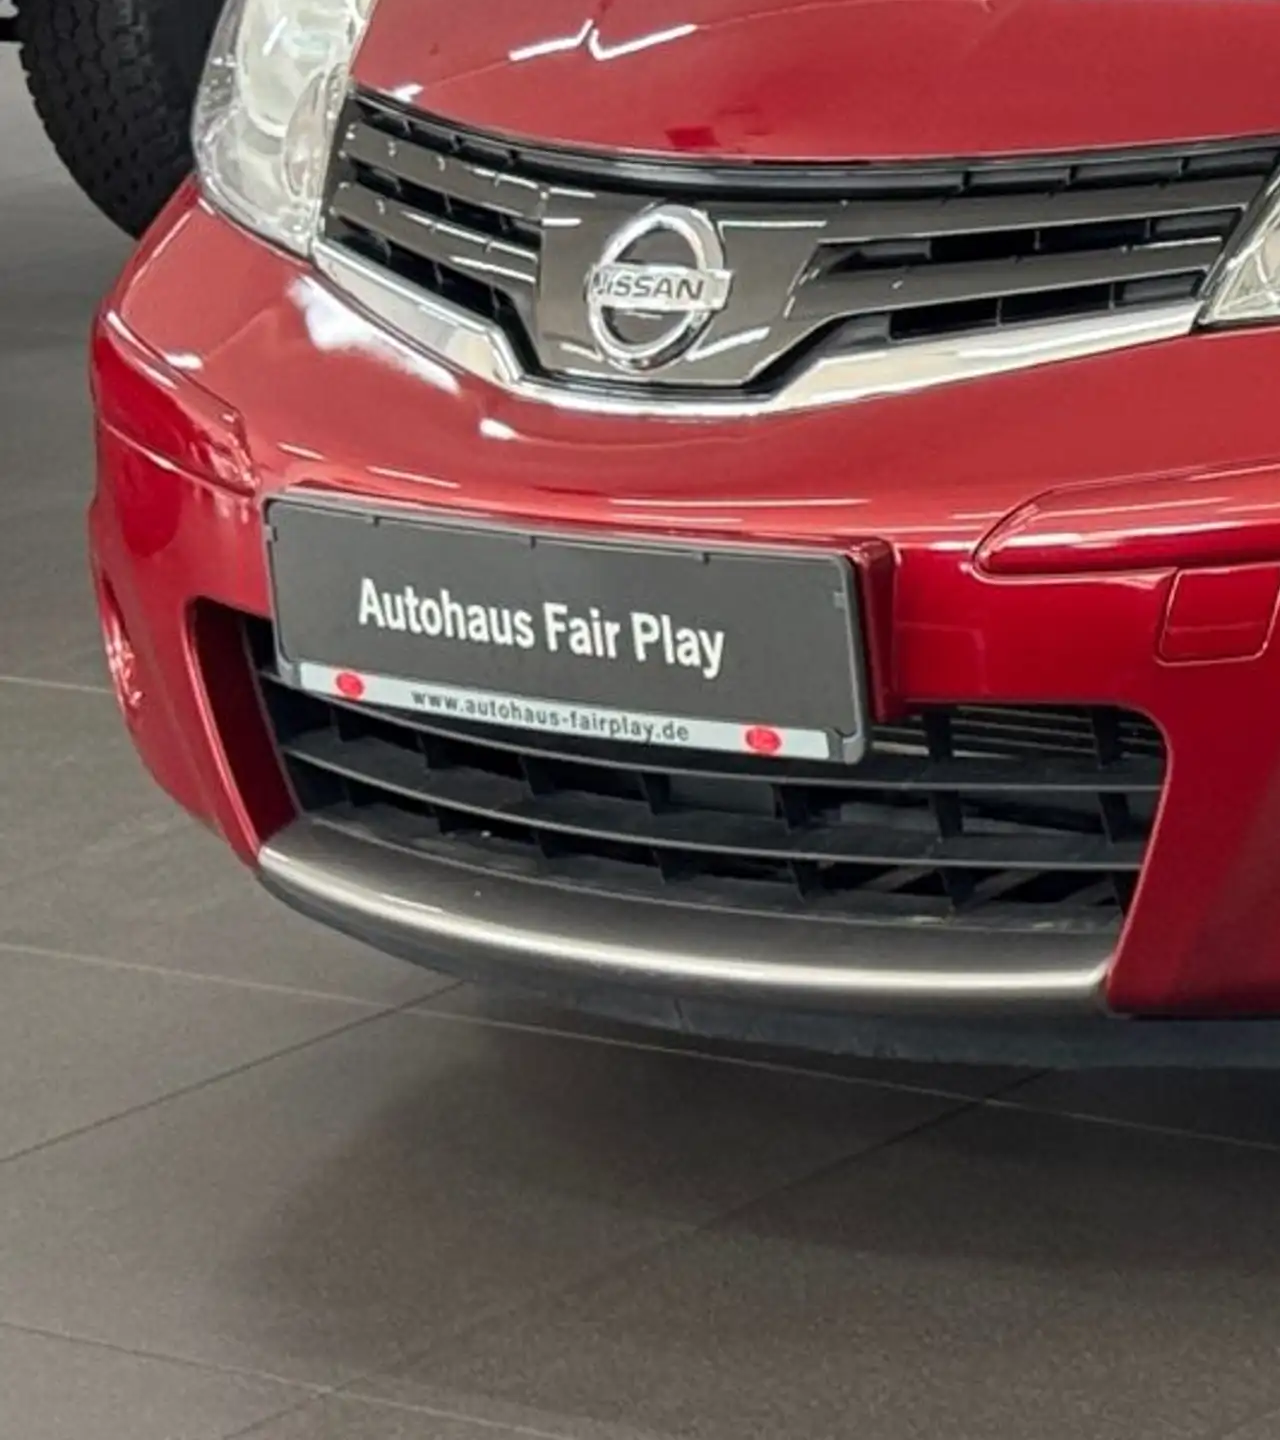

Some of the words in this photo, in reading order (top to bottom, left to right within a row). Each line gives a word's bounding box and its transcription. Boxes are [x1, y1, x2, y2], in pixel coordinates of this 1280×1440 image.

[591, 272, 704, 301] NISSAN
[357, 576, 536, 649] Autohaus
[541, 601, 622, 659] Fair
[630, 611, 726, 680] Play
[411, 690, 690, 744] www.autohaus-fairplay.de
